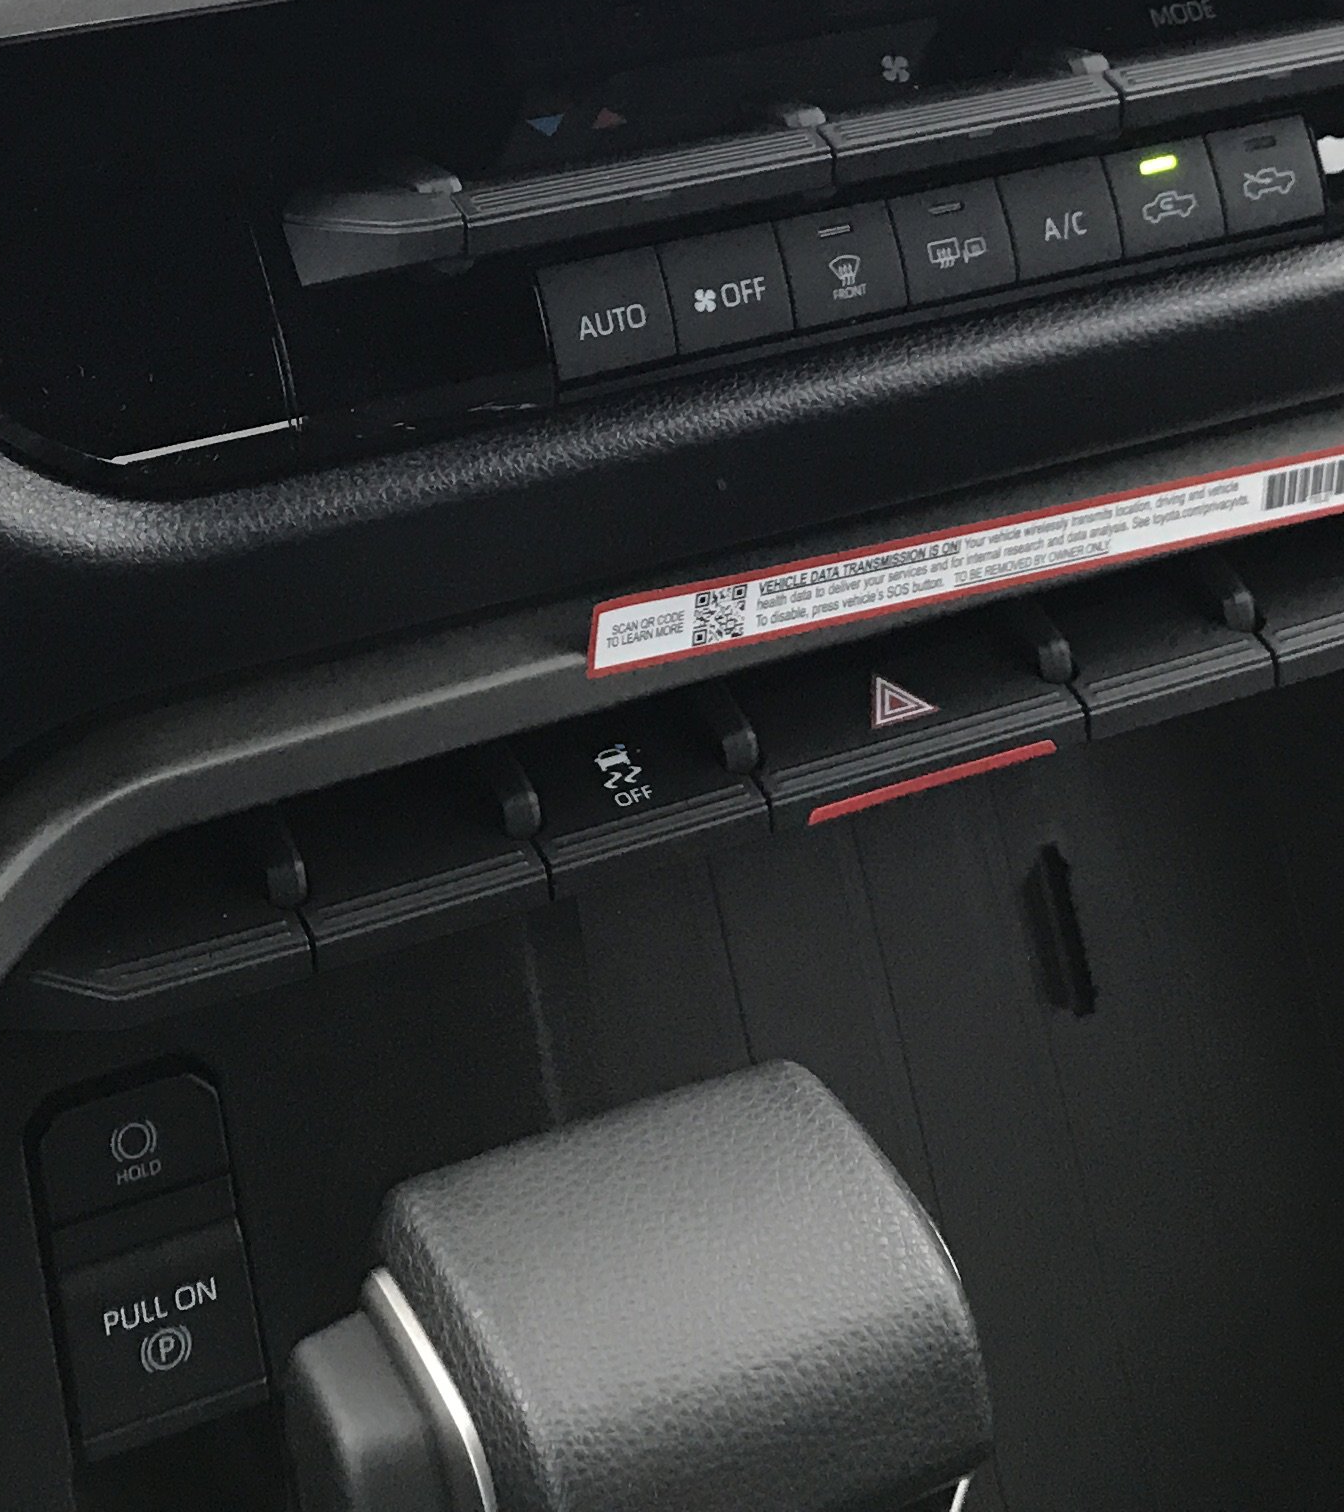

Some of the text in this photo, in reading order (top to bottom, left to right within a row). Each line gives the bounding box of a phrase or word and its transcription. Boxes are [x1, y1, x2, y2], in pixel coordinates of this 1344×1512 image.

[1044, 210, 1088, 242] A/C
[720, 276, 767, 308] OFF
[832, 283, 867, 301] FRONT
[579, 303, 648, 341] AUTO
[757, 594, 787, 610] health
[790, 589, 812, 604] data
[815, 586, 826, 598] to
[828, 579, 861, 595] deliver
[863, 574, 886, 589] your
[888, 564, 928, 583] services
[930, 557, 948, 572] and
[759, 572, 808, 594] VEHICLE
[810, 567, 840, 583] DATA
[843, 548, 926, 575] TRANSMISSION
[928, 544, 940, 558] IS
[756, 613, 768, 627] To
[812, 600, 839, 618] press
[842, 589, 885, 609] vehicle's
[886, 582, 910, 599] SOS
[606, 621, 684, 648] TO LEARN MORE
[611, 609, 685, 636] SCAN QR CODE
[613, 784, 654, 808] OFF
[116, 1159, 162, 1185] HOLD
[103, 1276, 218, 1336] PULL ON
